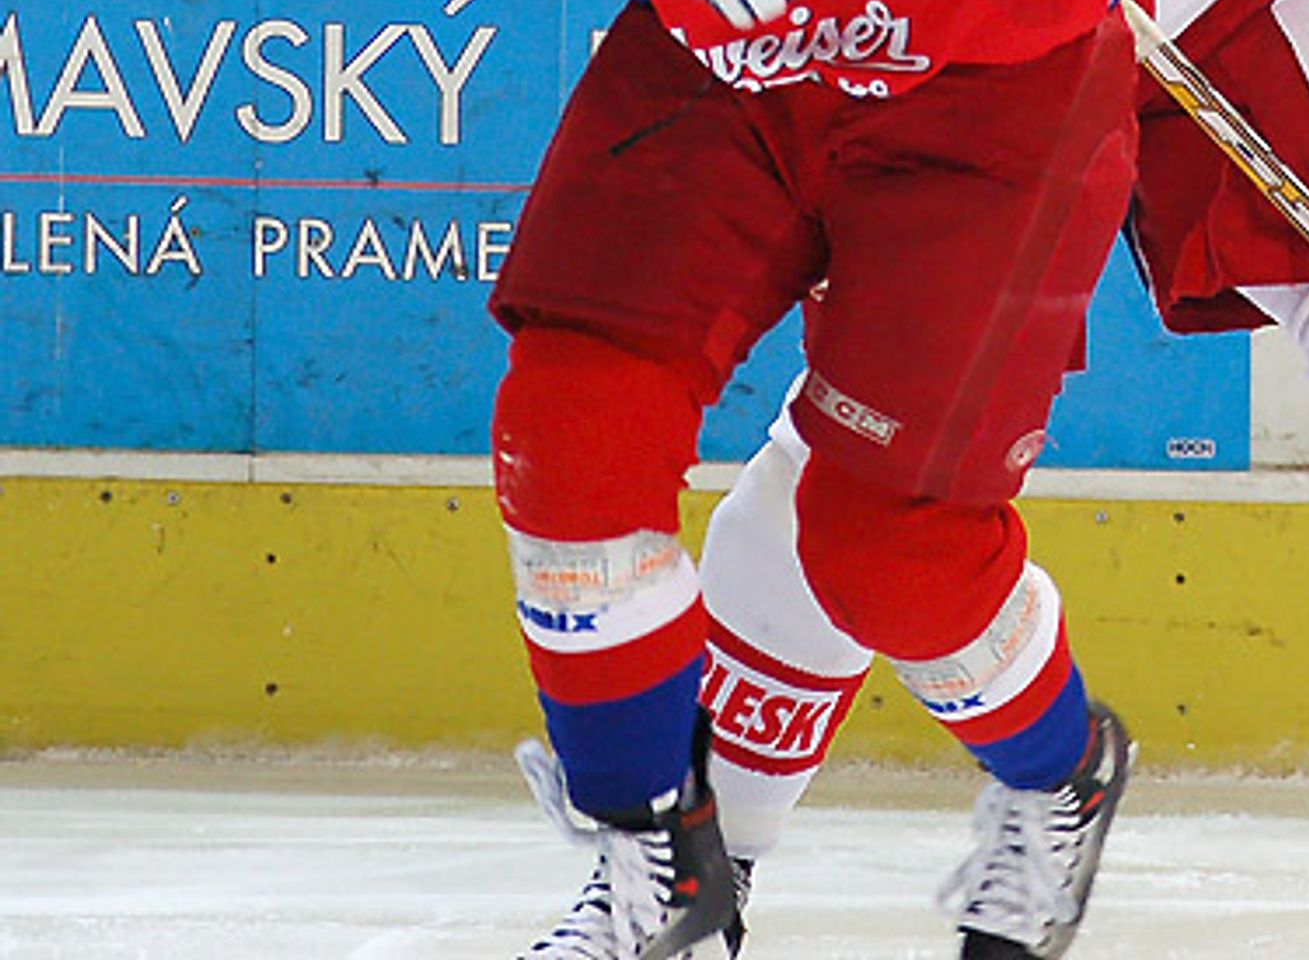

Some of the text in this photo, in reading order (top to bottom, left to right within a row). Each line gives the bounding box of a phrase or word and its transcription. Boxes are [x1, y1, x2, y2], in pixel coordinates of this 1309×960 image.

[672, 0, 931, 82] weiser
[3, 196, 203, 276] LENÁ
[702, 652, 832, 753] LESK
